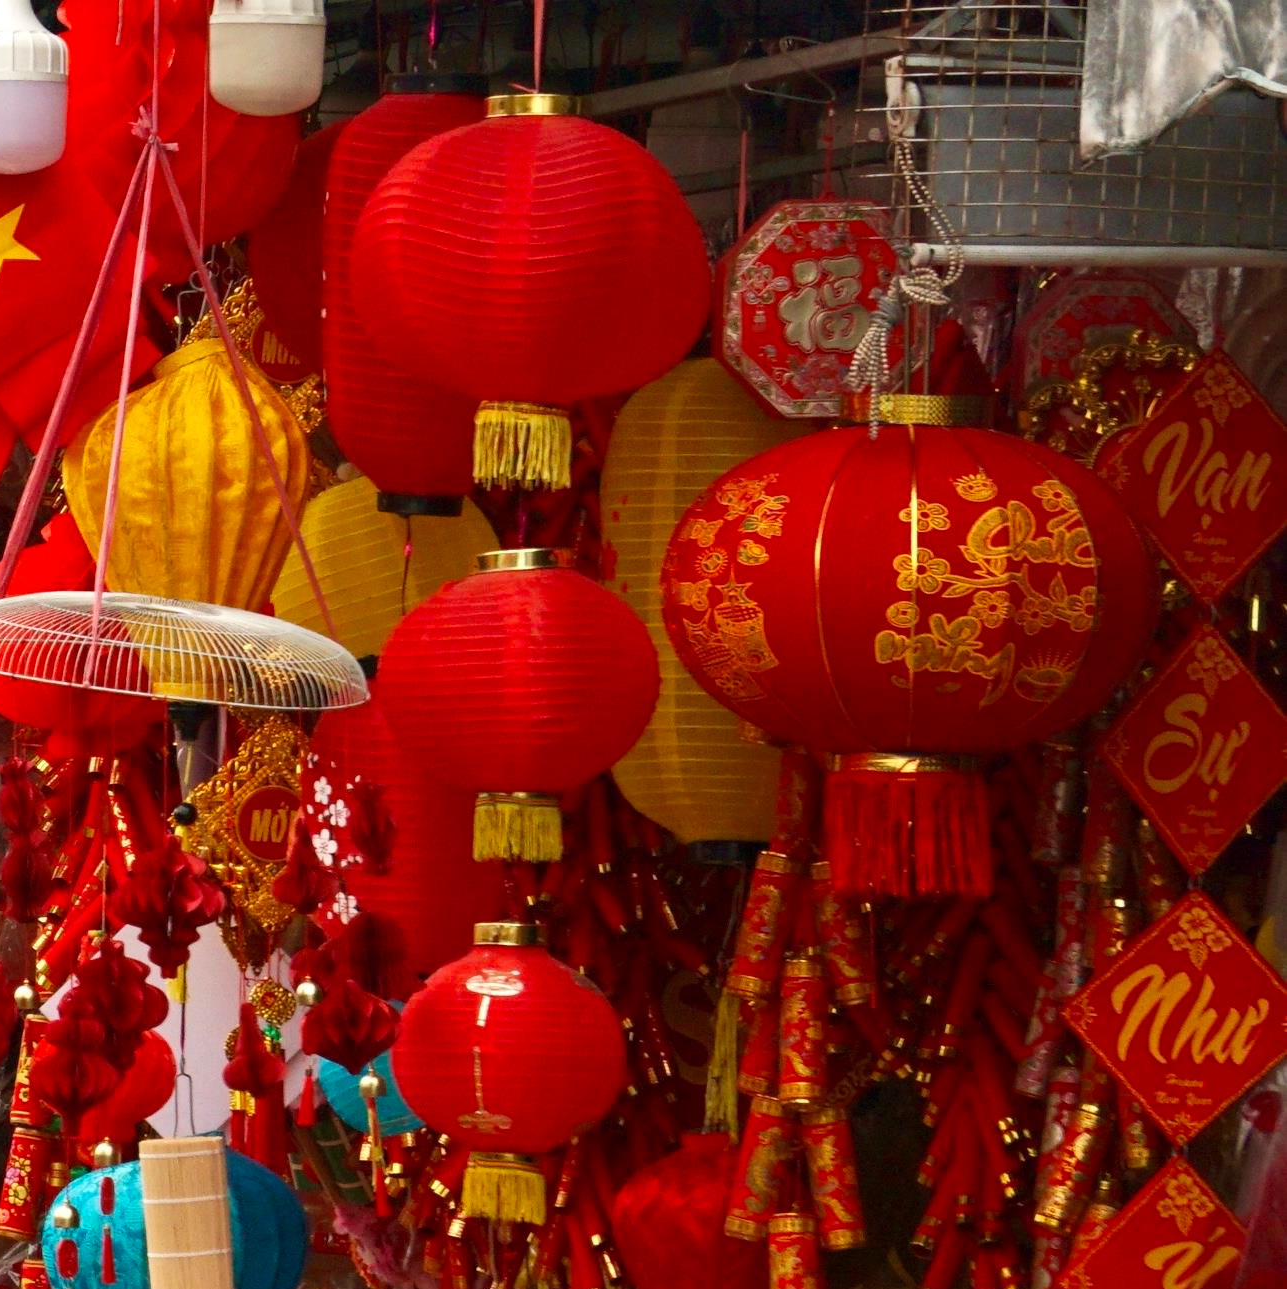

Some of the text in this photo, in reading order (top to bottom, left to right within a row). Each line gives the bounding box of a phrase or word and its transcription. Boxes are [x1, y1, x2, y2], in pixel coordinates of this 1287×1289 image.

[777, 256, 869, 354] 福
[1143, 417, 1272, 530] Vạn
[1143, 692, 1252, 803] Sự
[1111, 963, 1270, 1065] Như
